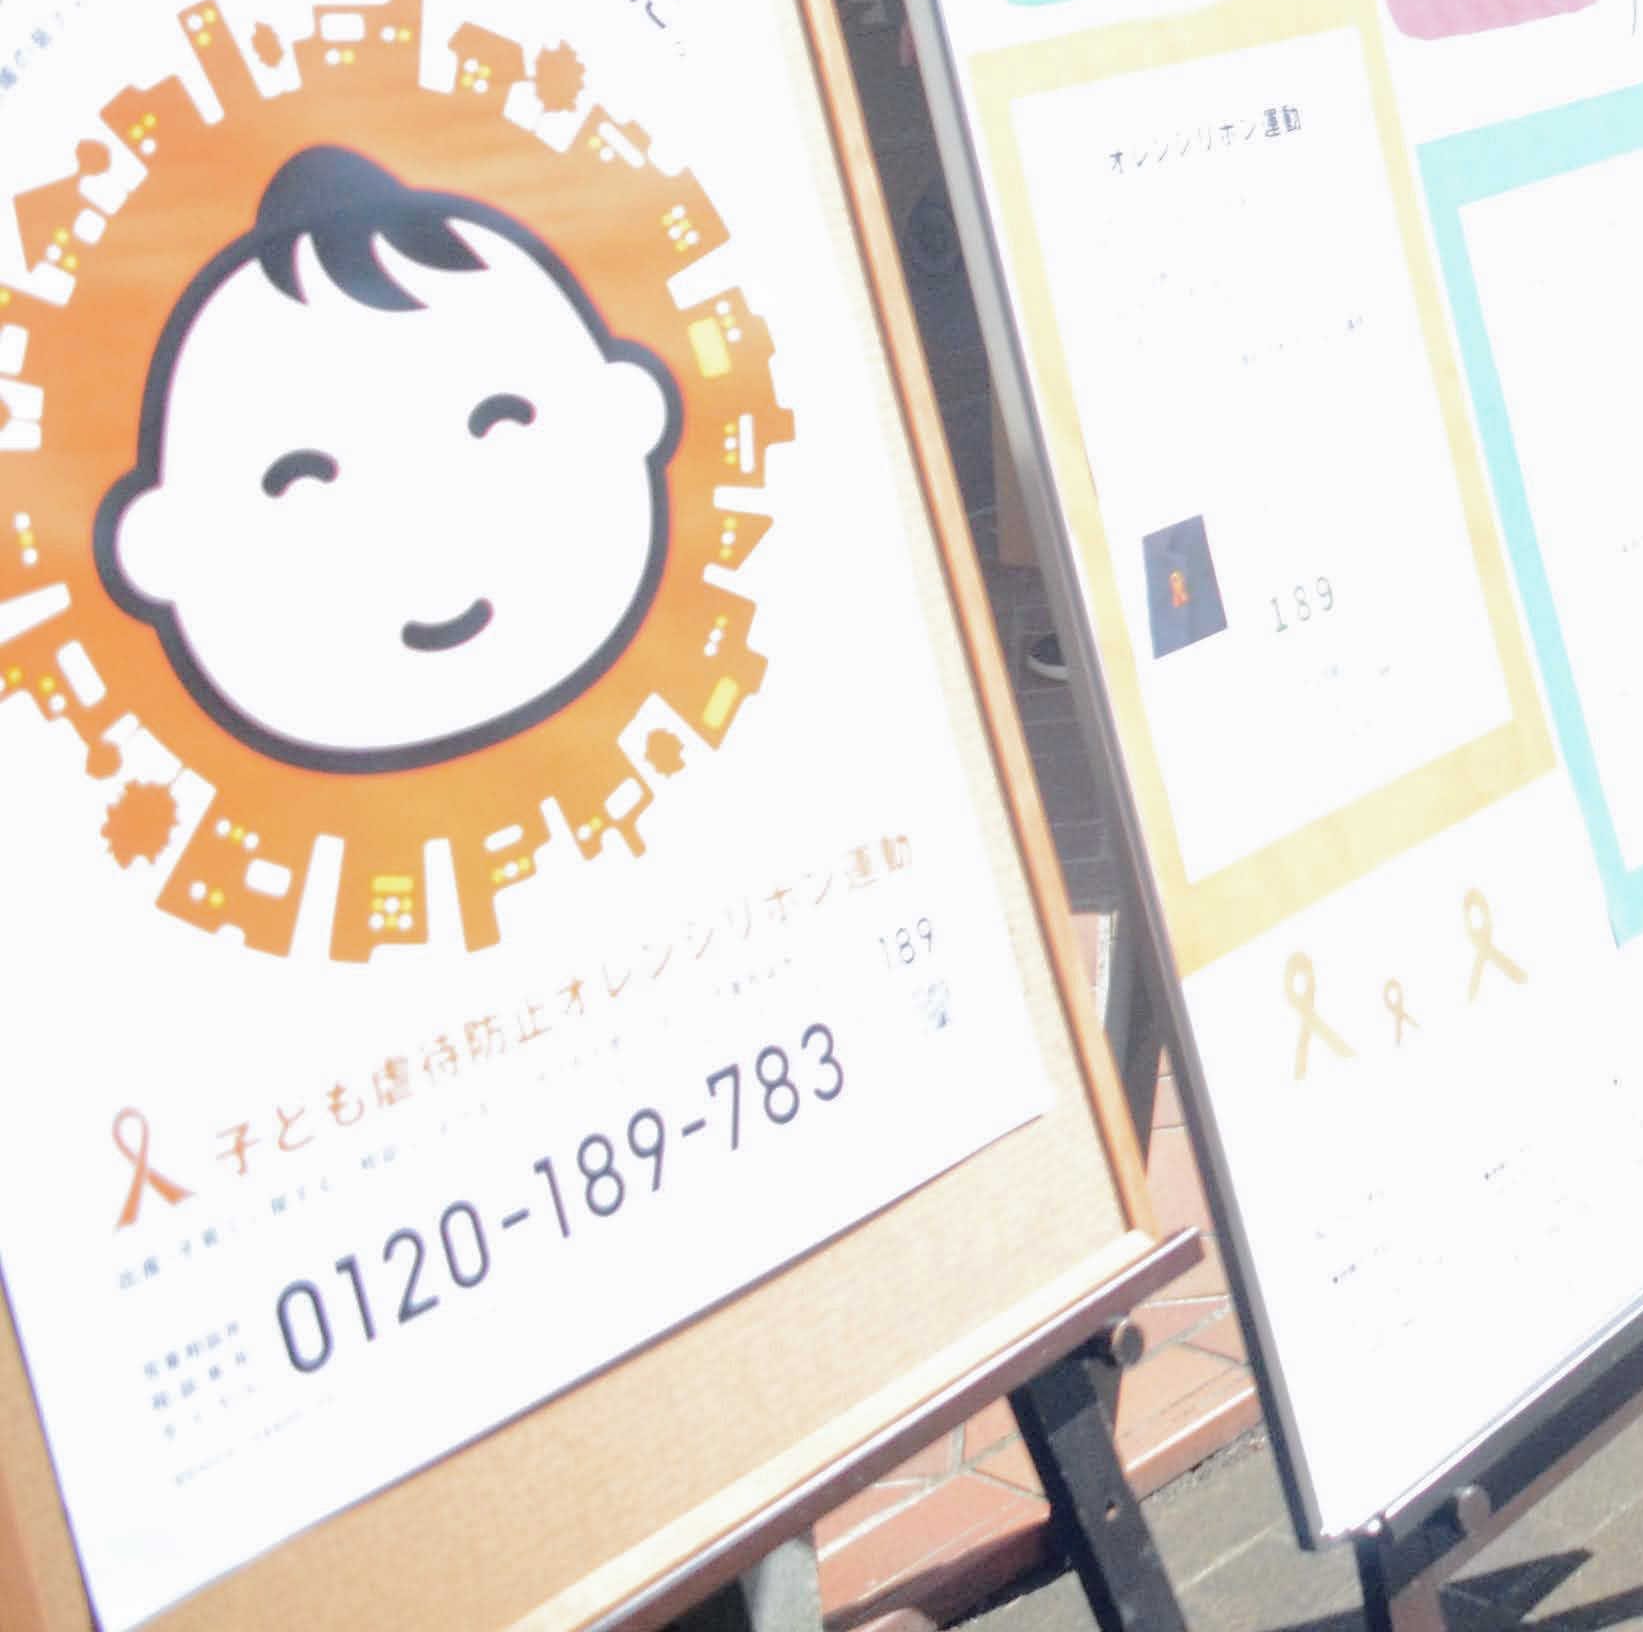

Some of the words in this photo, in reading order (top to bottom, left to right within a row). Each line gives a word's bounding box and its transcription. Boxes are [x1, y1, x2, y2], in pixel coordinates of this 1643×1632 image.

[1269, 576, 1334, 633] 189
[876, 915, 938, 971] 189
[273, 1021, 846, 1376] 0120-189-783
